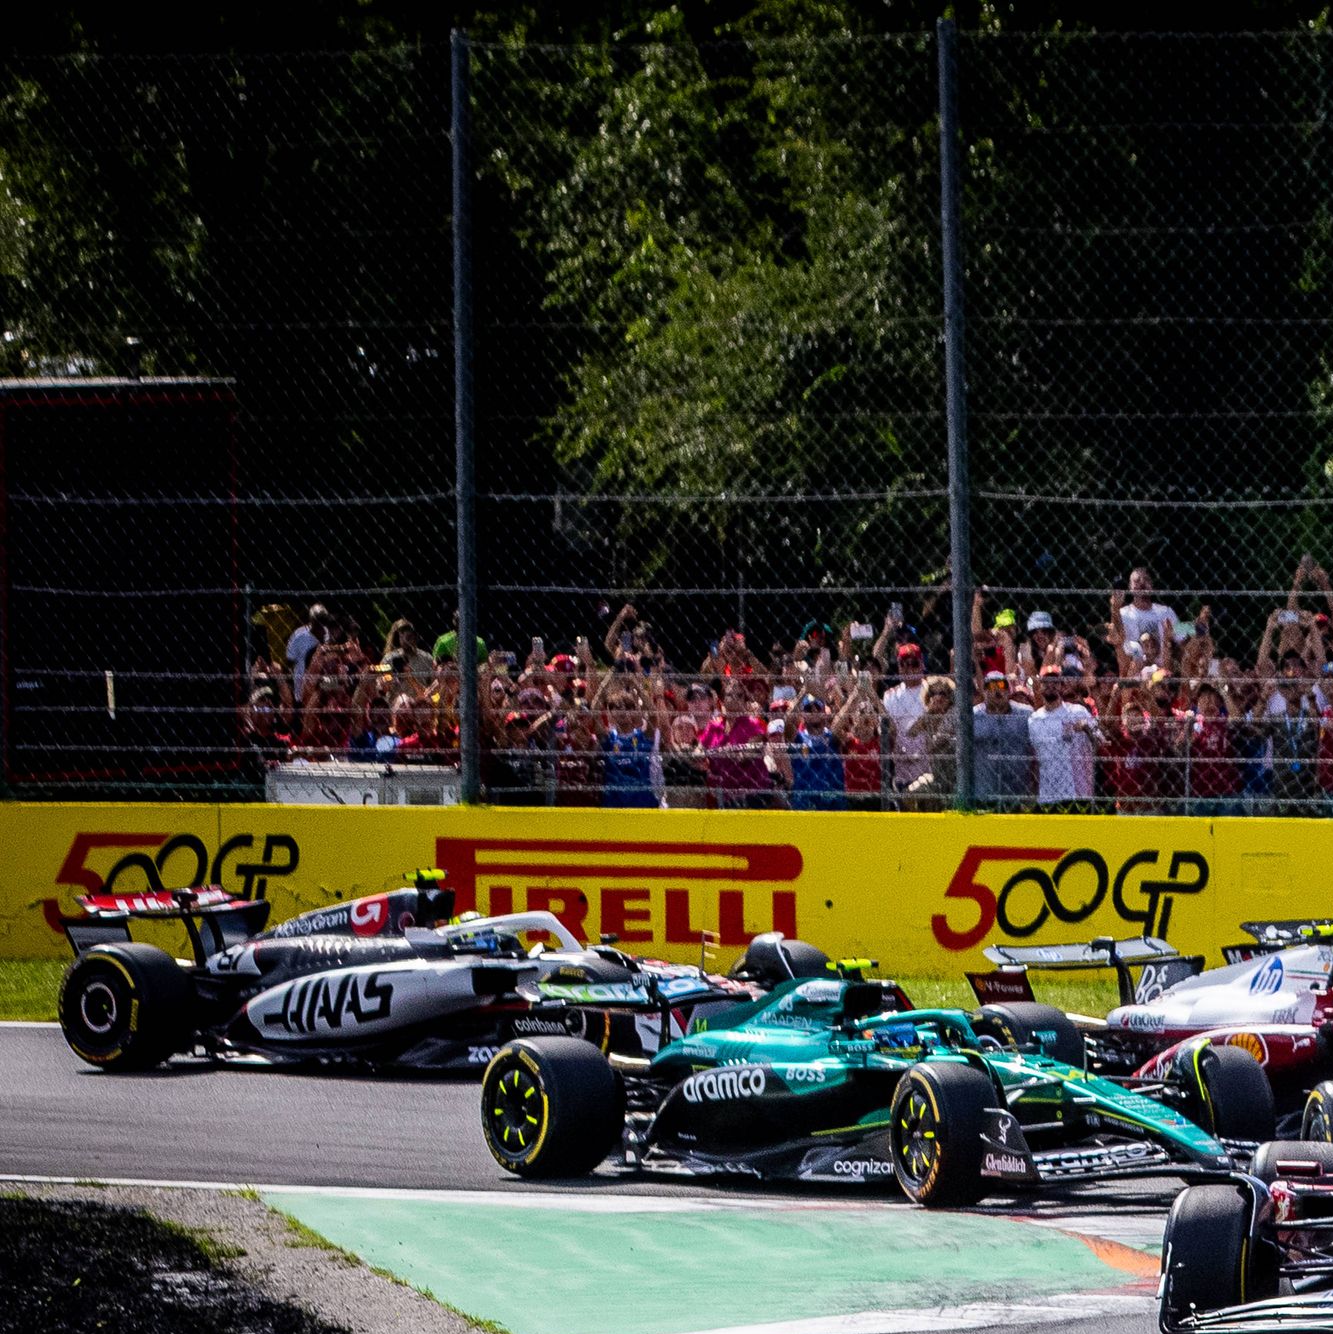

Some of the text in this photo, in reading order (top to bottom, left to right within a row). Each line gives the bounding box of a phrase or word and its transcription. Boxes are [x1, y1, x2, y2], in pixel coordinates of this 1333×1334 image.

[435, 837, 803, 945] PIRELLI
[931, 845, 1210, 951] 500GP
[264, 970, 411, 1033] HAAS
[514, 1016, 567, 1034] coinbase
[695, 1018, 707, 1032] 14
[683, 1068, 766, 1103] aramco
[786, 1067, 826, 1083] BOSS
